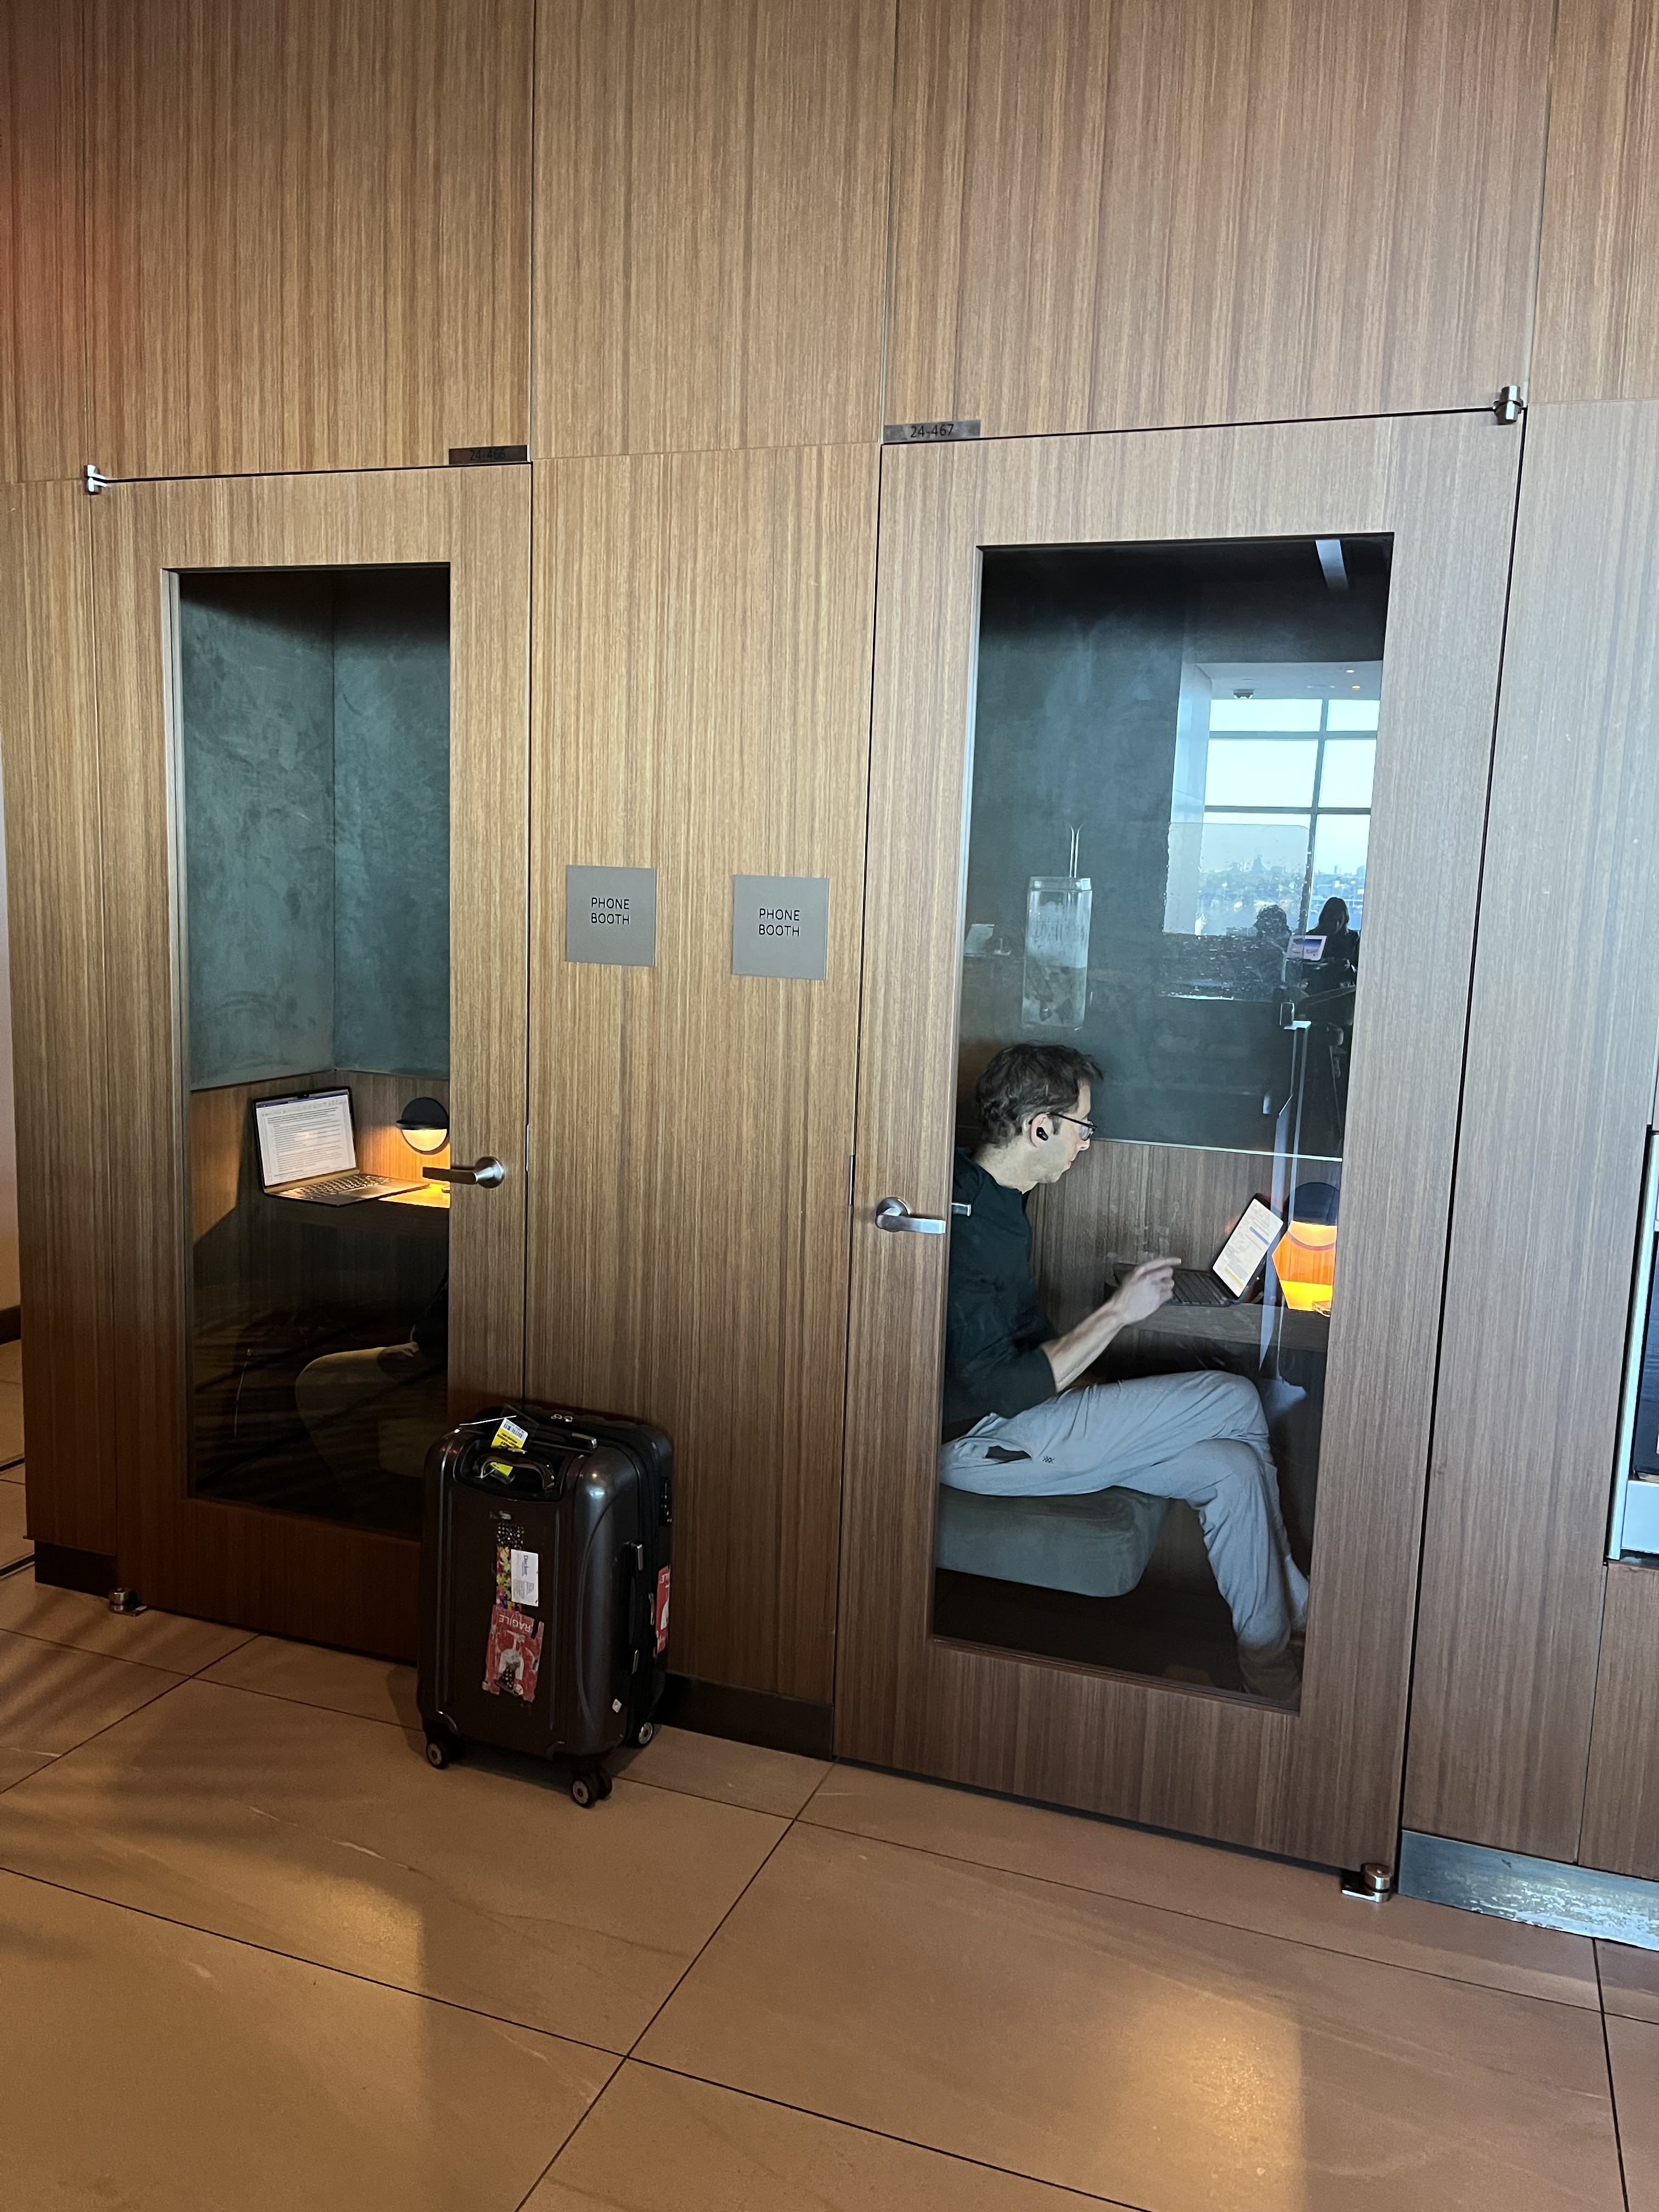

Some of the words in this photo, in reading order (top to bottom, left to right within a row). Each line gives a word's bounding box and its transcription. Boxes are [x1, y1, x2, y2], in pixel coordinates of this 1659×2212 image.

[911, 424, 953, 438] 24-467
[591, 897, 630, 910] PHONE
[591, 912, 629, 925] BOOTH
[759, 908, 800, 921] PHONE
[759, 924, 799, 936] BOOTH
[499, 1614, 531, 1633] RAGILE
